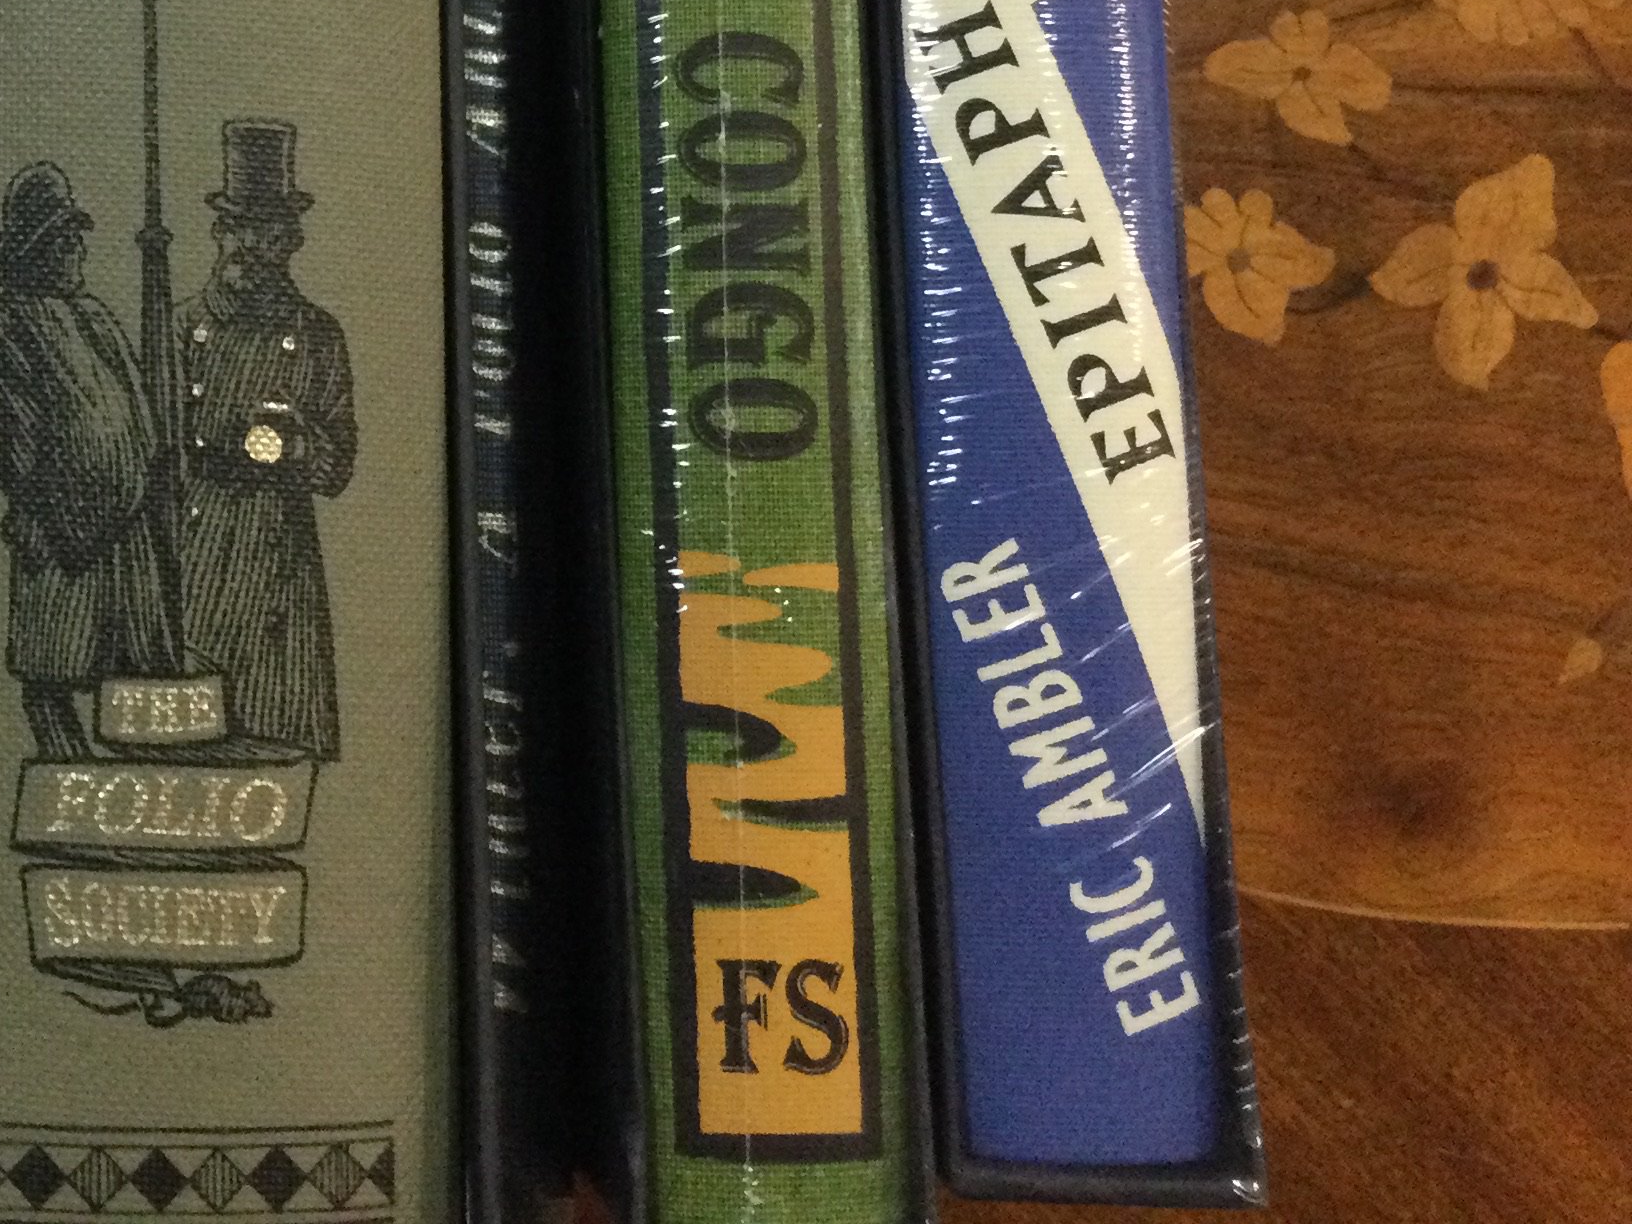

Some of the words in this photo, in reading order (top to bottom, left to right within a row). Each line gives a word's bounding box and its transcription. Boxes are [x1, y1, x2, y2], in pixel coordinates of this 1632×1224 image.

[673, 30, 820, 463] CONGO
[911, 0, 1177, 485] EPITAPH
[111, 684, 217, 734] THE
[940, 536, 1131, 828] AMBLER
[45, 771, 287, 843] FOLIO
[44, 877, 287, 948] SOCIETY
[1068, 855, 1203, 1038] ERIC
[711, 958, 851, 1076] FS
